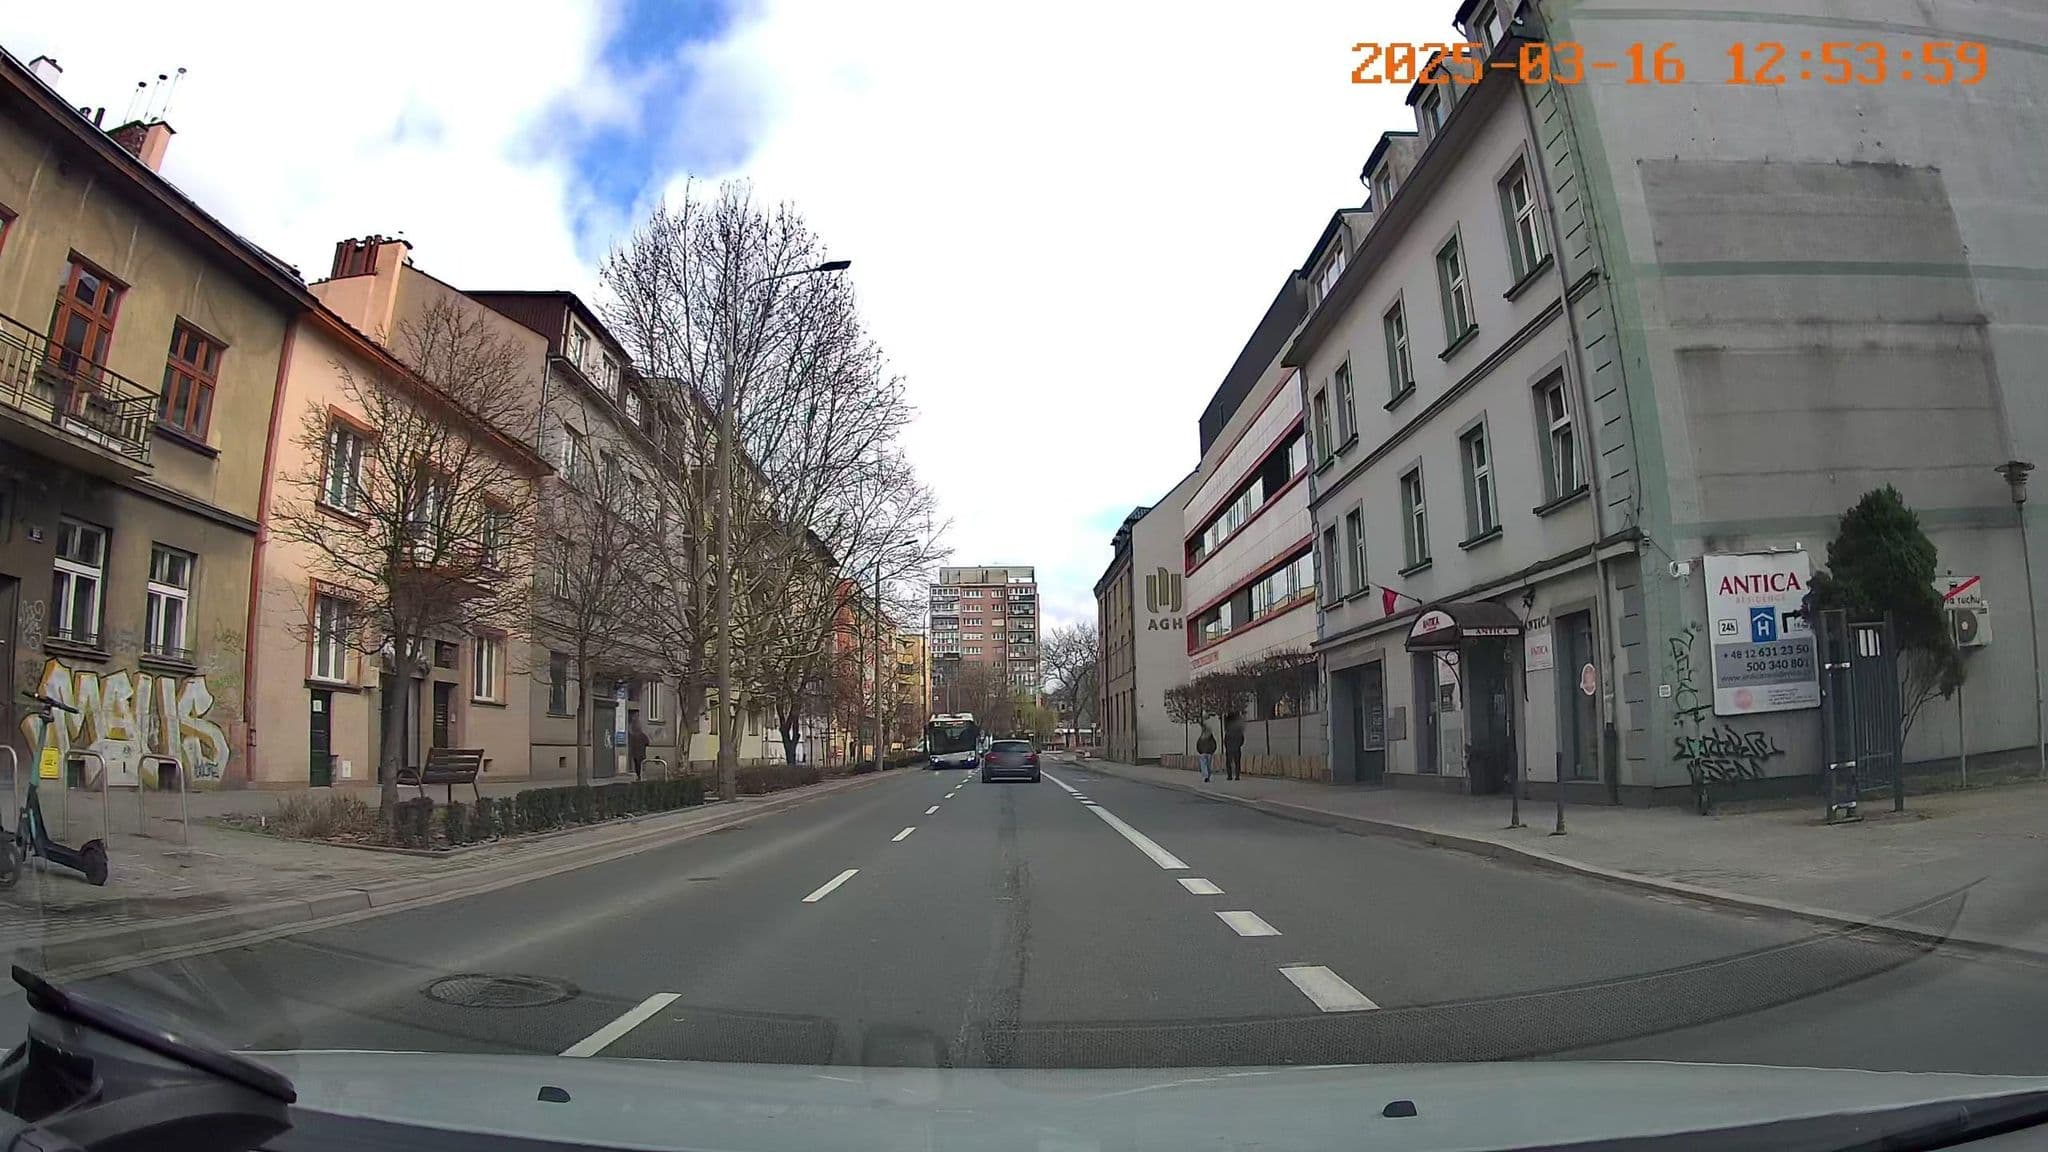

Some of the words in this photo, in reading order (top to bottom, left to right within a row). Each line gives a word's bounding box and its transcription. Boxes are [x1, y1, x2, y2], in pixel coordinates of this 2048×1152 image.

[1719, 572, 1801, 595] ANTICA
[1148, 618, 1183, 631] AGH
[1721, 623, 1735, 632] 24h
[1731, 650, 1742, 659] 48
[1745, 650, 1756, 658] 12
[1758, 647, 1777, 657] 631
[1781, 645, 1793, 655] 23
[1796, 644, 1809, 654] 50
[1746, 661, 1766, 671] 500
[1768, 660, 1788, 670] 340
